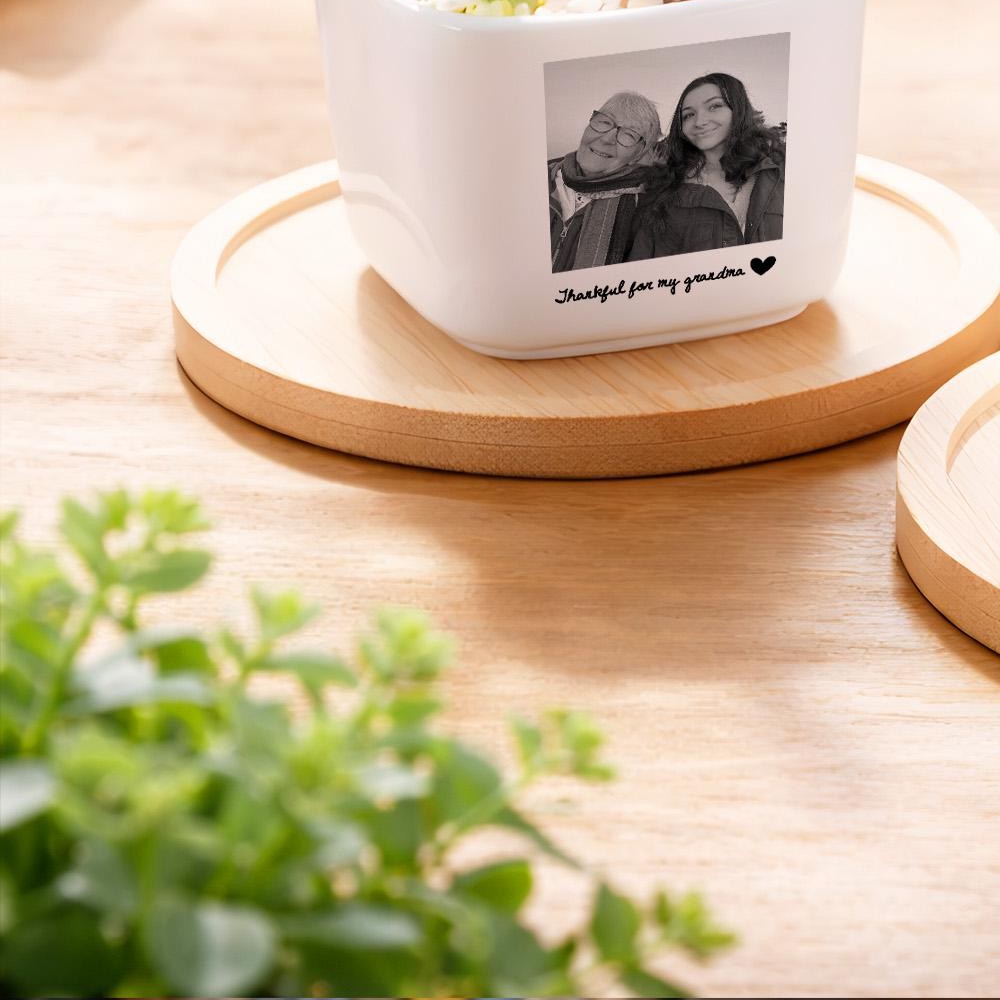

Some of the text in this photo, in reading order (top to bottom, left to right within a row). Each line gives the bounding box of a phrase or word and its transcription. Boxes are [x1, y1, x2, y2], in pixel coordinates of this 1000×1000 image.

[554, 265, 746, 304] Thankful for my grandma
